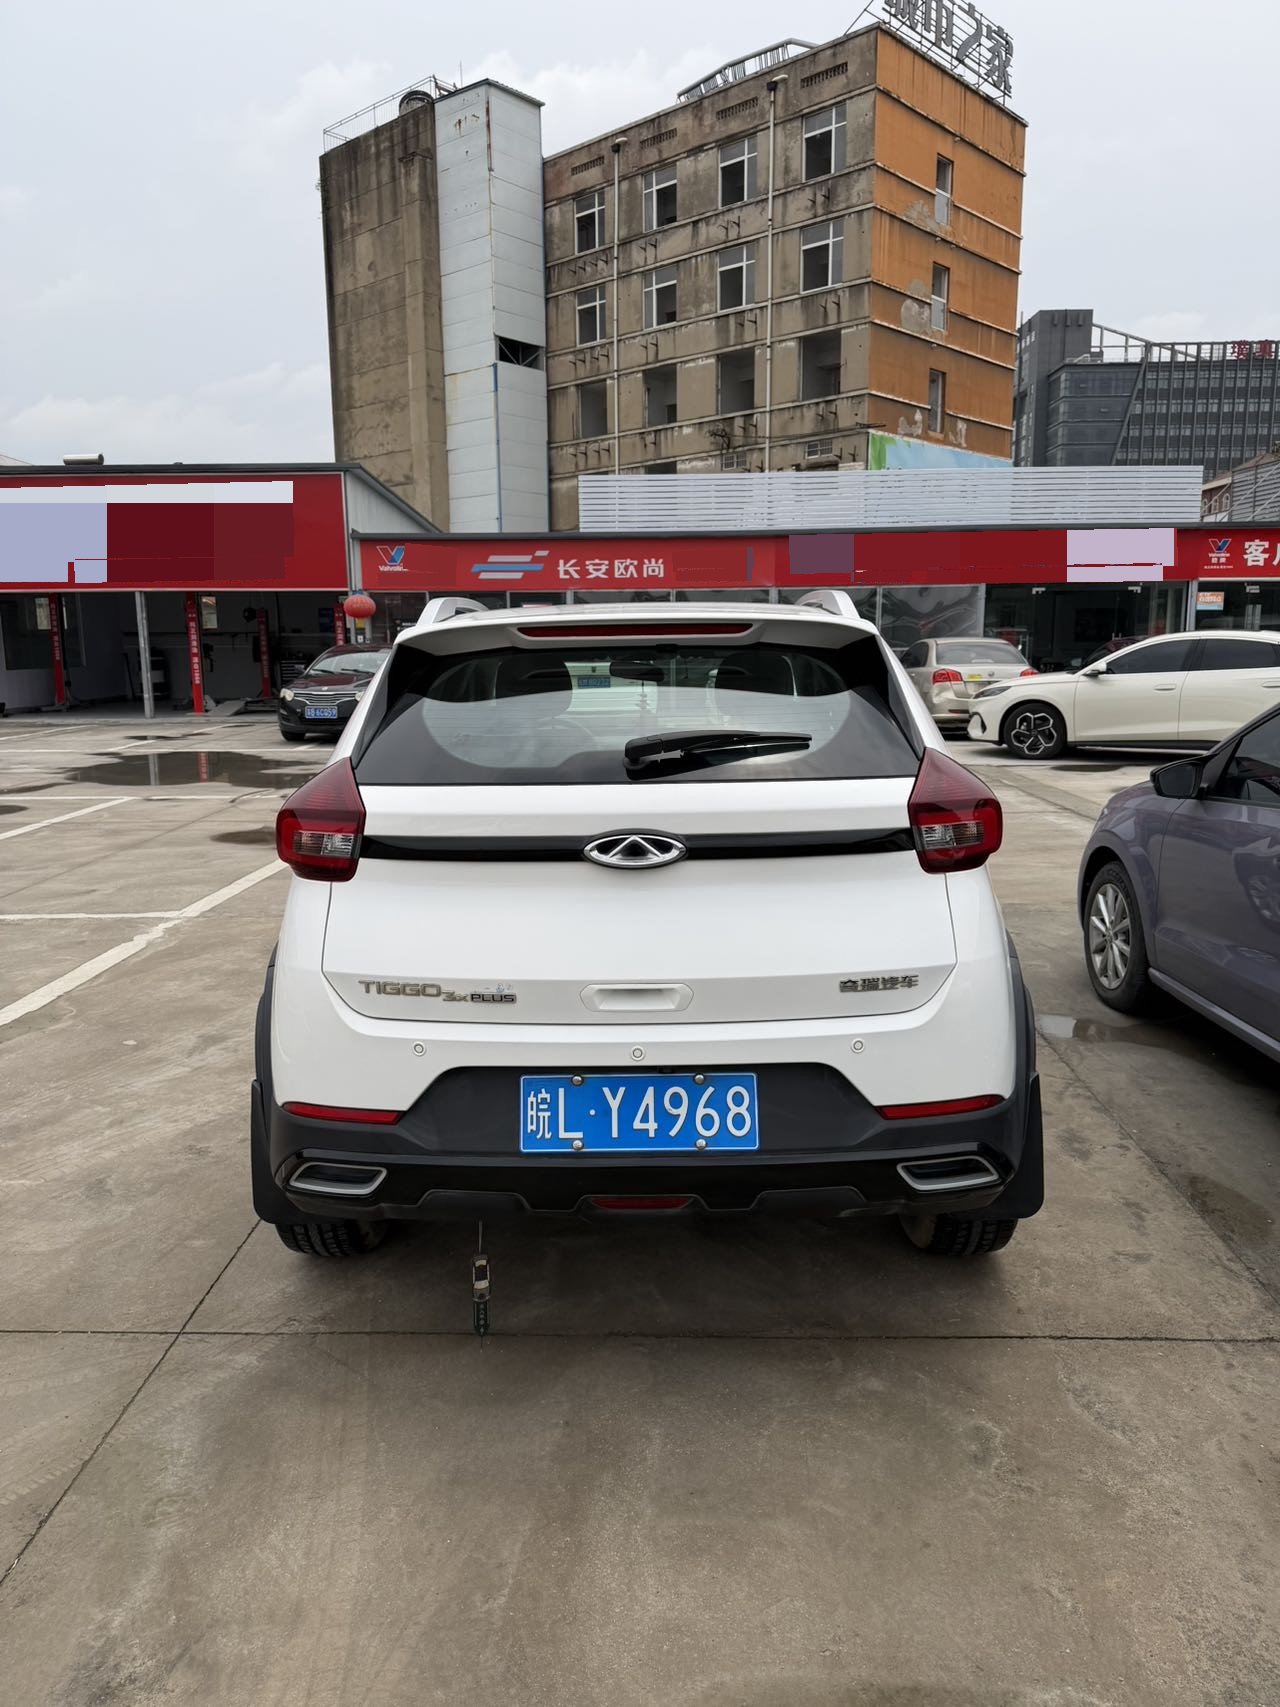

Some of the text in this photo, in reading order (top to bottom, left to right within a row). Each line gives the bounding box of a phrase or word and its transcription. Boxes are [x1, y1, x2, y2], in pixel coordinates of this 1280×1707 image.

[1243, 539, 1280, 567] 客
[557, 558, 664, 579] 长安欧尚
[358, 980, 442, 998] TIGGO
[470, 993, 518, 1004] PLUS
